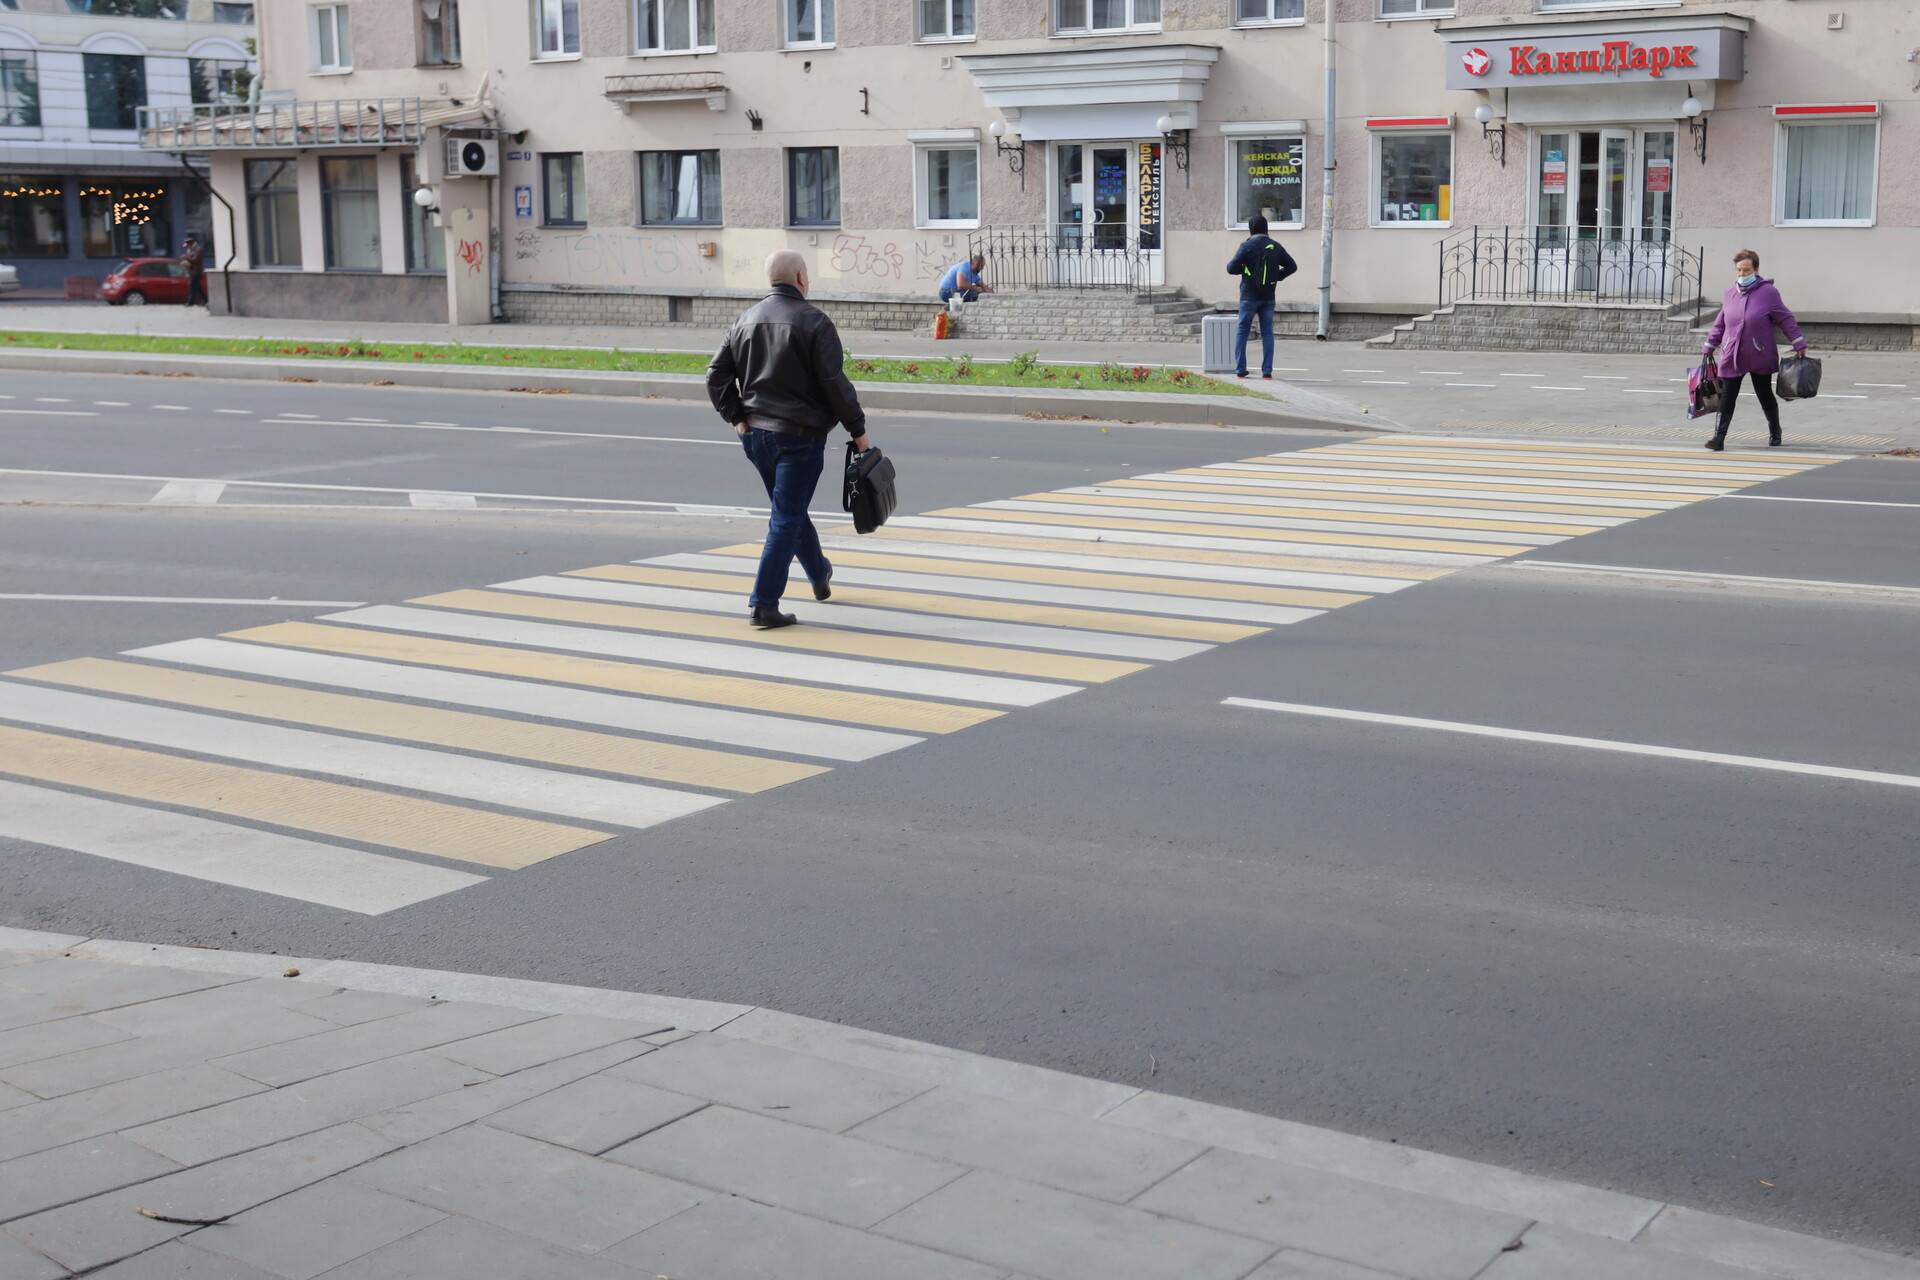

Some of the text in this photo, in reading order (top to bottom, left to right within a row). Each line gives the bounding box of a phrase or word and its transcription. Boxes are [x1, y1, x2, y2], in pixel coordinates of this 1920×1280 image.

[1508, 41, 1698, 77] КанцПарк
[1242, 152, 1290, 161] ЖЕНСКАЯ
[1248, 165, 1298, 175] ОДЕЖДА
[1252, 176, 1301, 186] ДЛЯ ДОМА
[1140, 144, 1152, 225] БЕЛАРУСЬ
[1152, 159, 1160, 224] ТЕКСТИЛЬ
